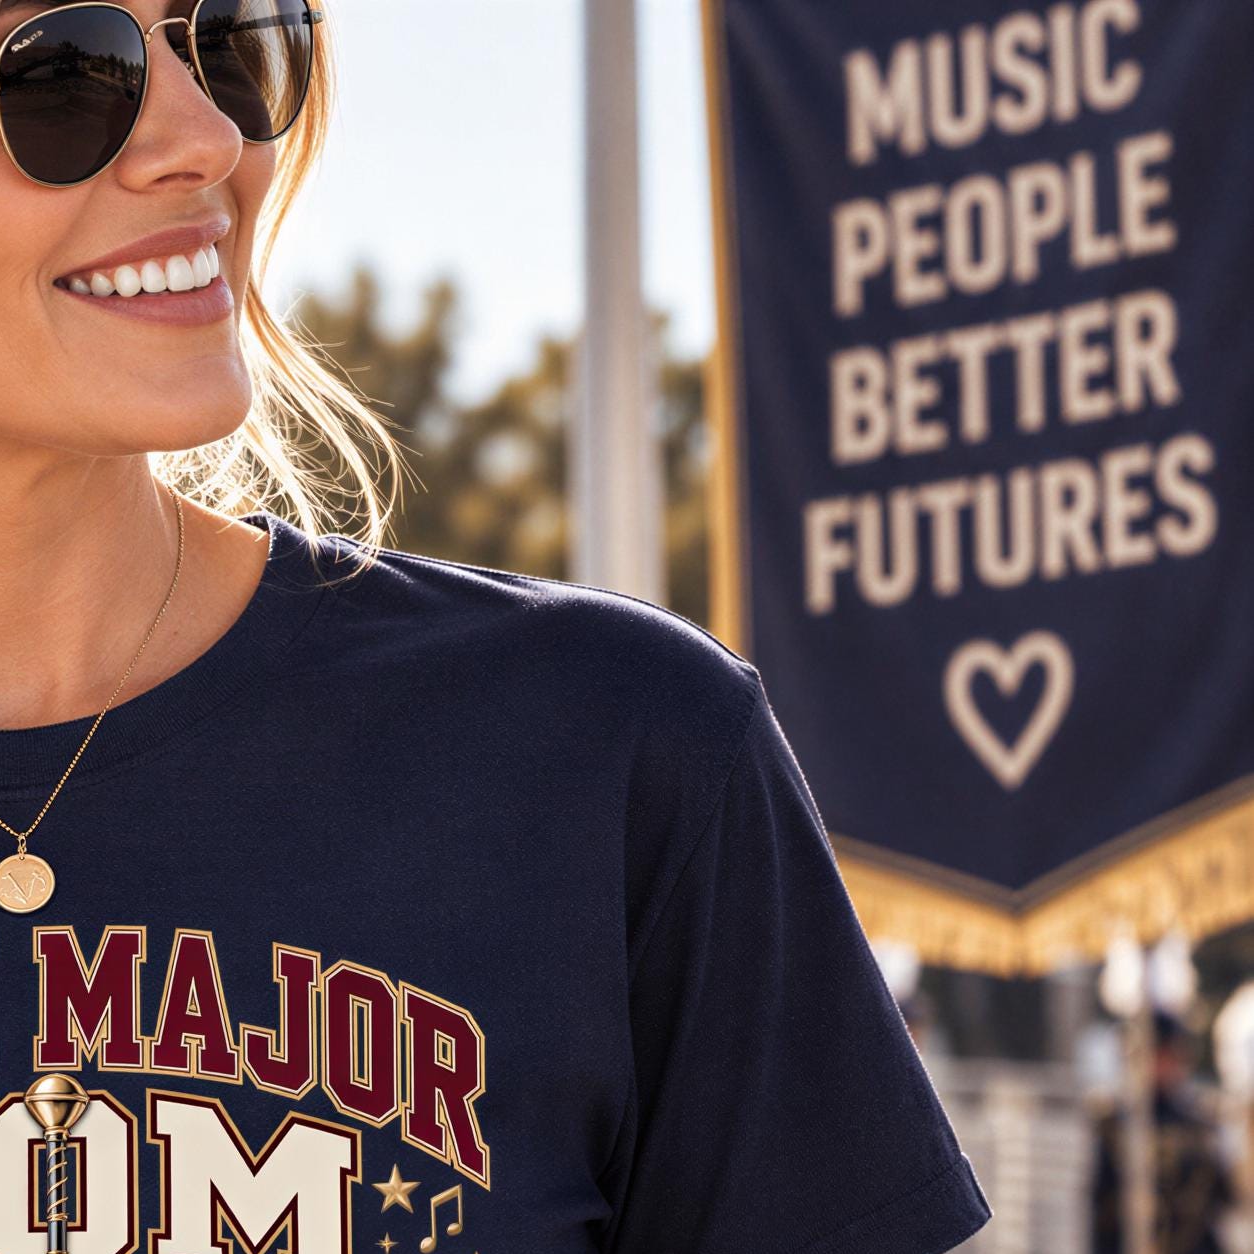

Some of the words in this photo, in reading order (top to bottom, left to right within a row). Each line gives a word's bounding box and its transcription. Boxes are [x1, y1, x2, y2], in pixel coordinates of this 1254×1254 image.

[845, 0, 1142, 164] MUSIC
[832, 131, 1177, 319] PEOPLE
[829, 289, 1182, 466] BETTER
[802, 433, 1219, 616] FUTURES
[33, 924, 491, 1190] MAJOR
